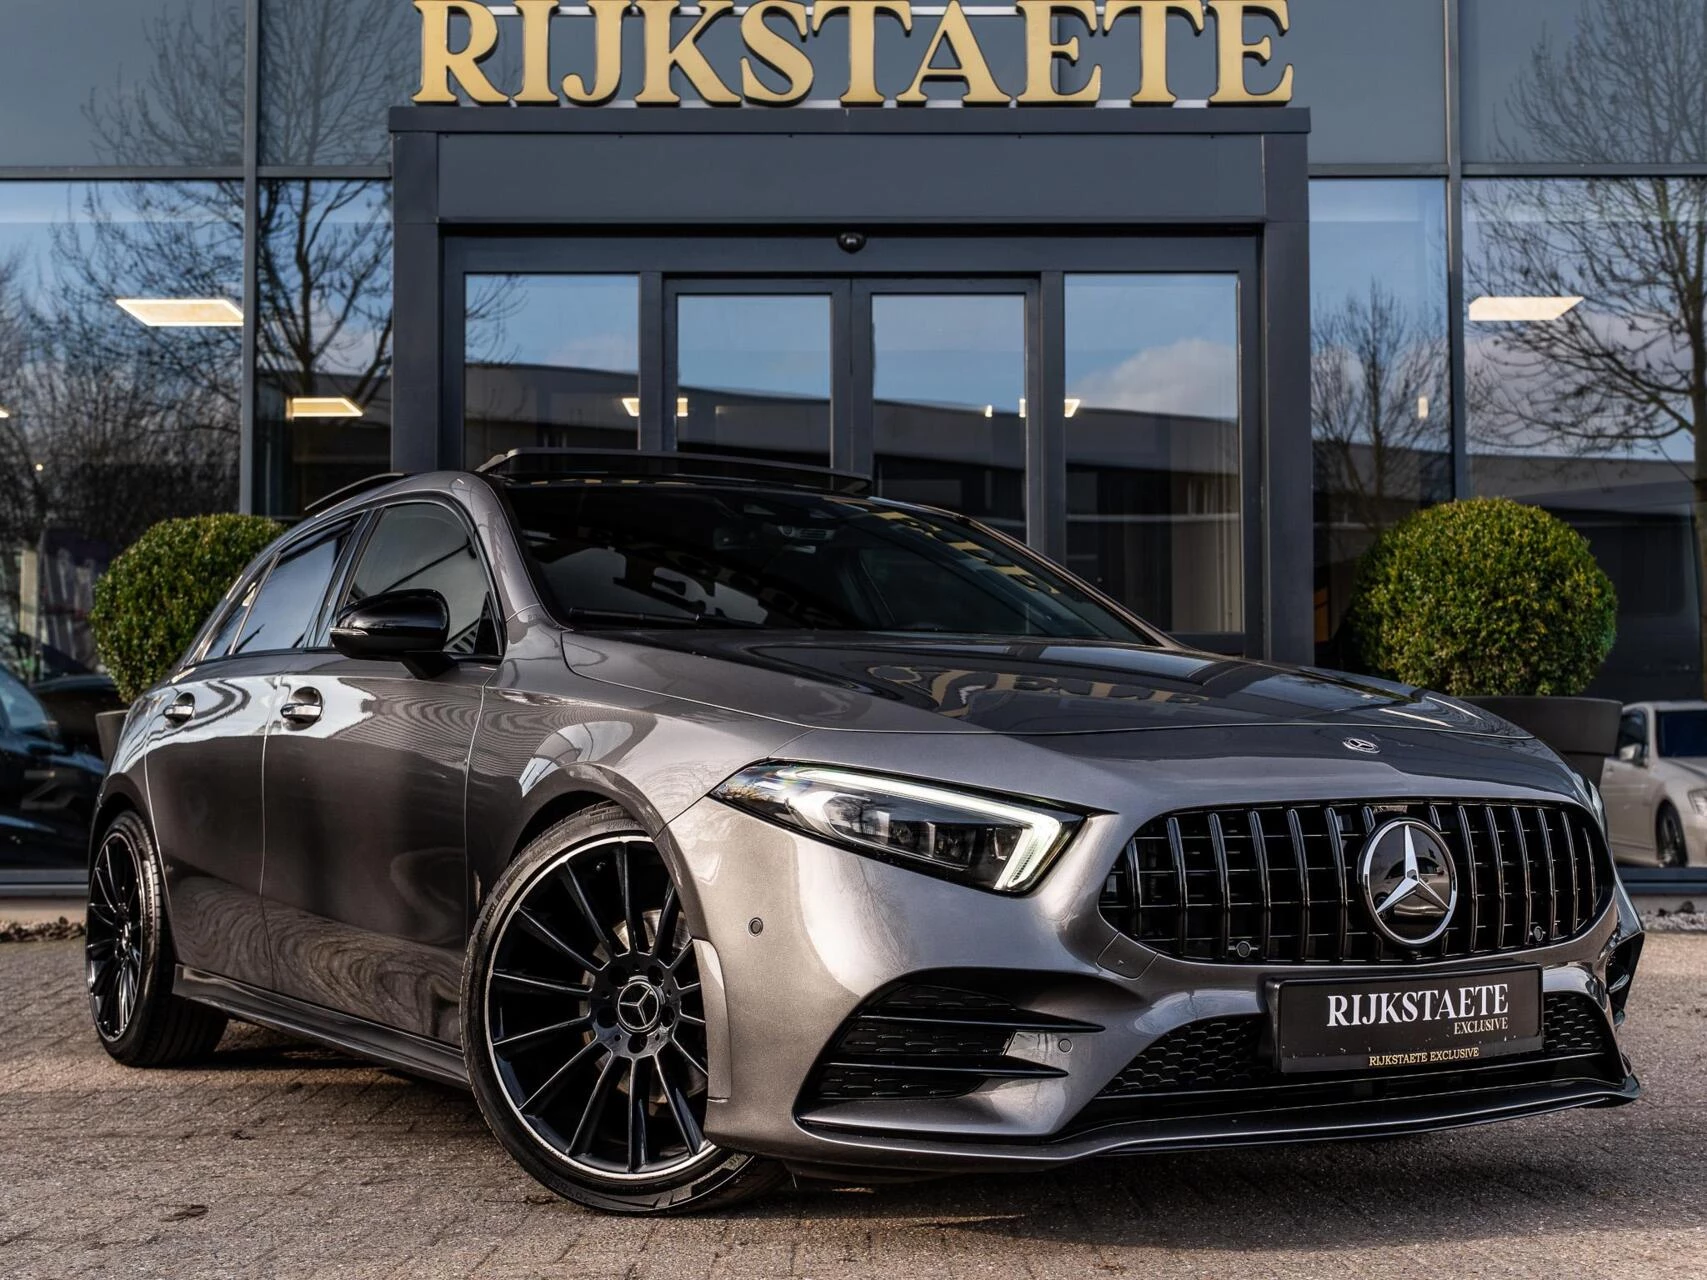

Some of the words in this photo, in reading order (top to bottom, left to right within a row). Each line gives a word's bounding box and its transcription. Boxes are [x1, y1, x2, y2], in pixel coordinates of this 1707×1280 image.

[411, 0, 1294, 105] RIJKSTAETE
[1327, 984, 1508, 1026] RIJKSTAETE
[1454, 1017, 1508, 1035] EXCLUSIVE
[1369, 1053, 1428, 1066] RIJKSTAETE
[1430, 1047, 1479, 1061] EXCLUSIVE
